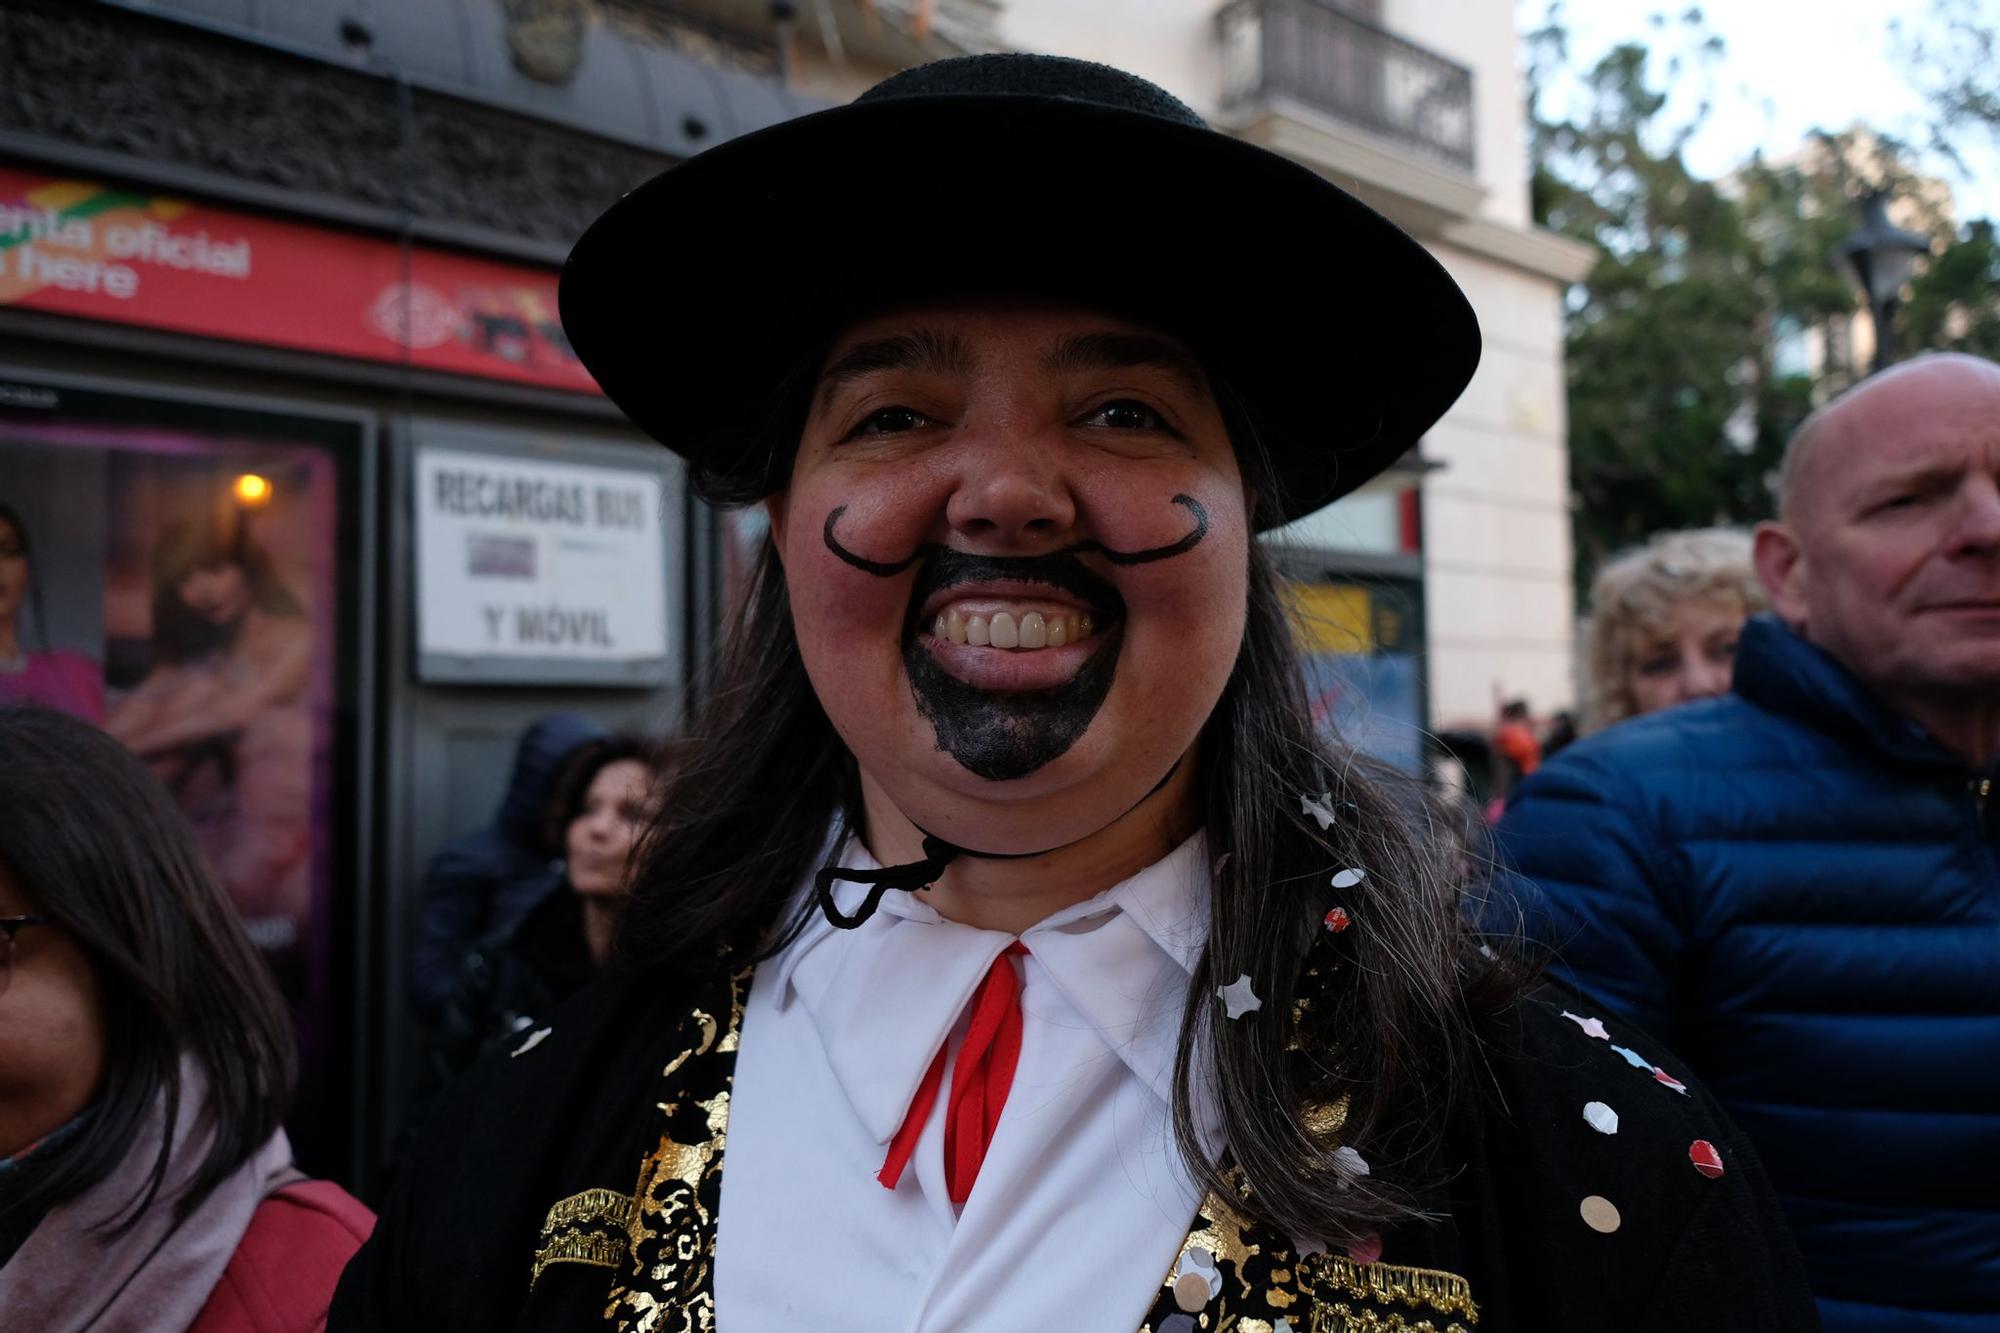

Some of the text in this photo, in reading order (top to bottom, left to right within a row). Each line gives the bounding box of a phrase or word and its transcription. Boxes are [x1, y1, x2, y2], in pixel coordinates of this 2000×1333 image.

[20, 245, 138, 299] here
[105, 221, 249, 279] oficial
[434, 469, 588, 525] RECARGAS
[482, 600, 613, 647] Y MÓVIL
